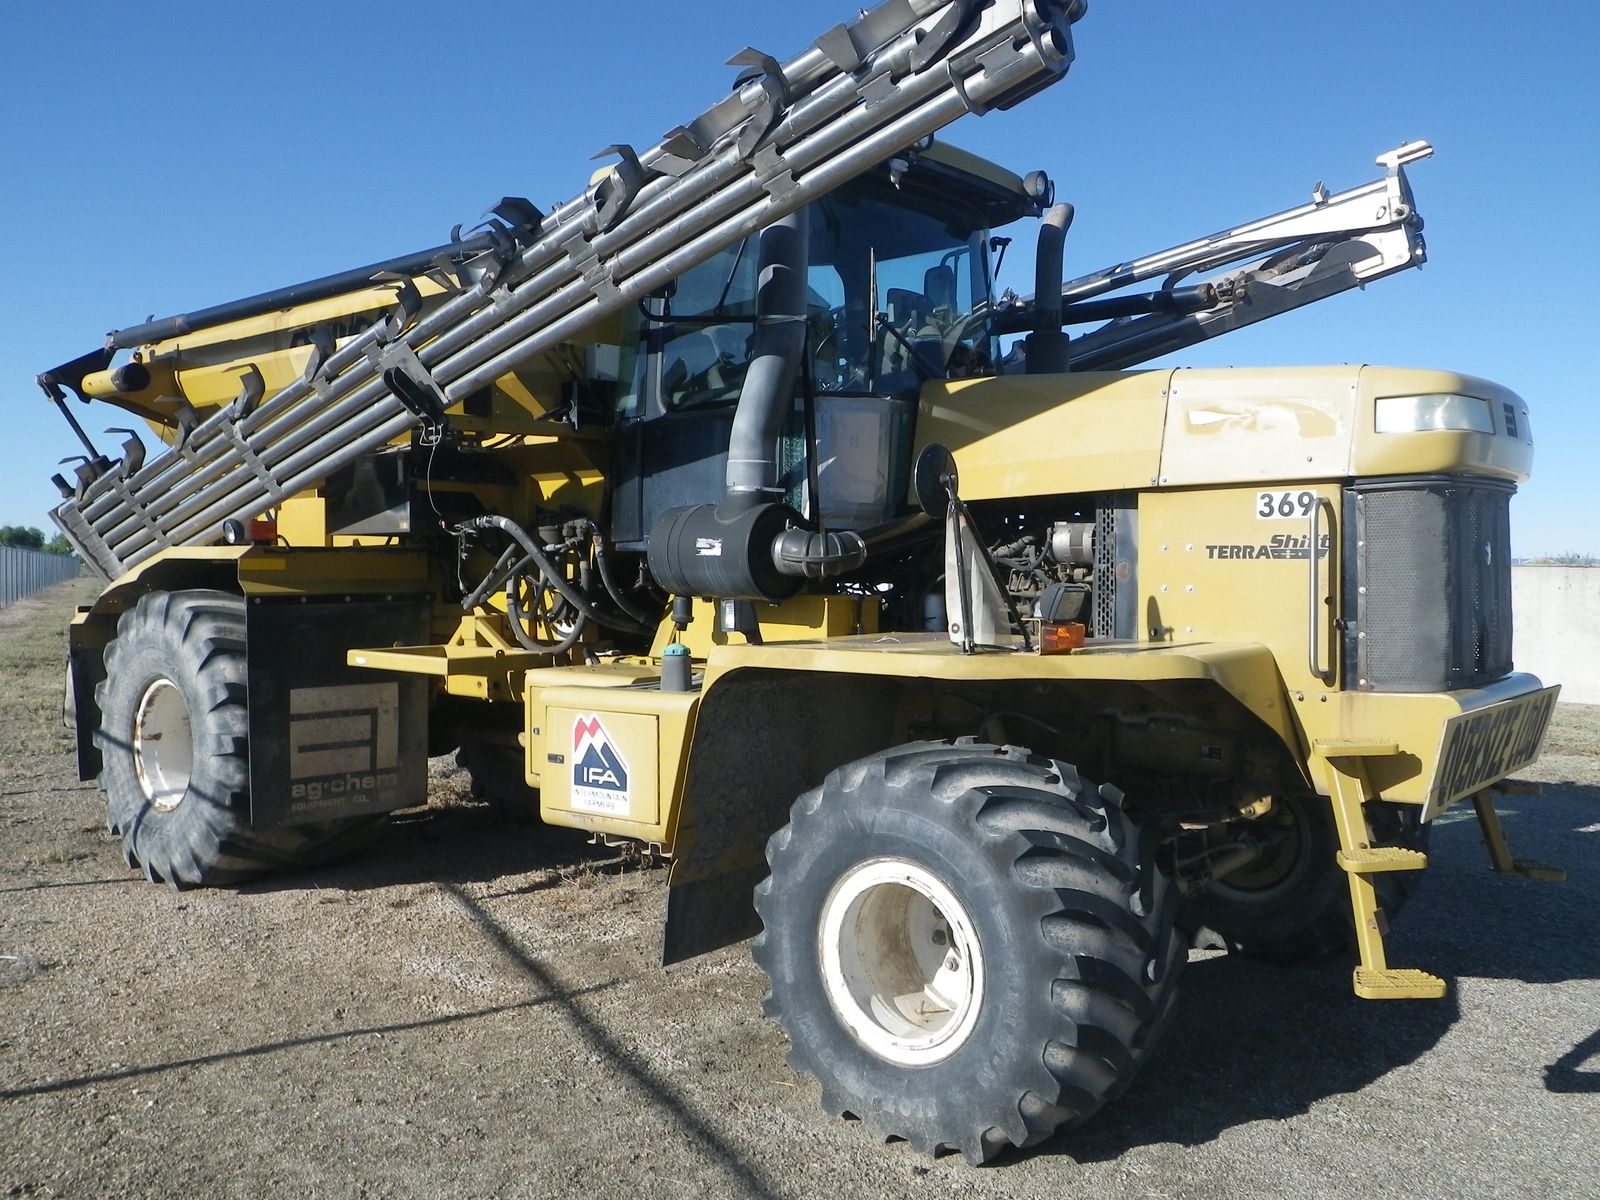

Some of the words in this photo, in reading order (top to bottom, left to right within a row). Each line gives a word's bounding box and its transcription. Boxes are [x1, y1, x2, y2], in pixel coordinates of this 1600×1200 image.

[1259, 491, 1314, 517] 369
[1206, 545, 1271, 560] TERRA
[1437, 703, 1522, 808] OVERSIZE
[583, 766, 621, 787] IFA
